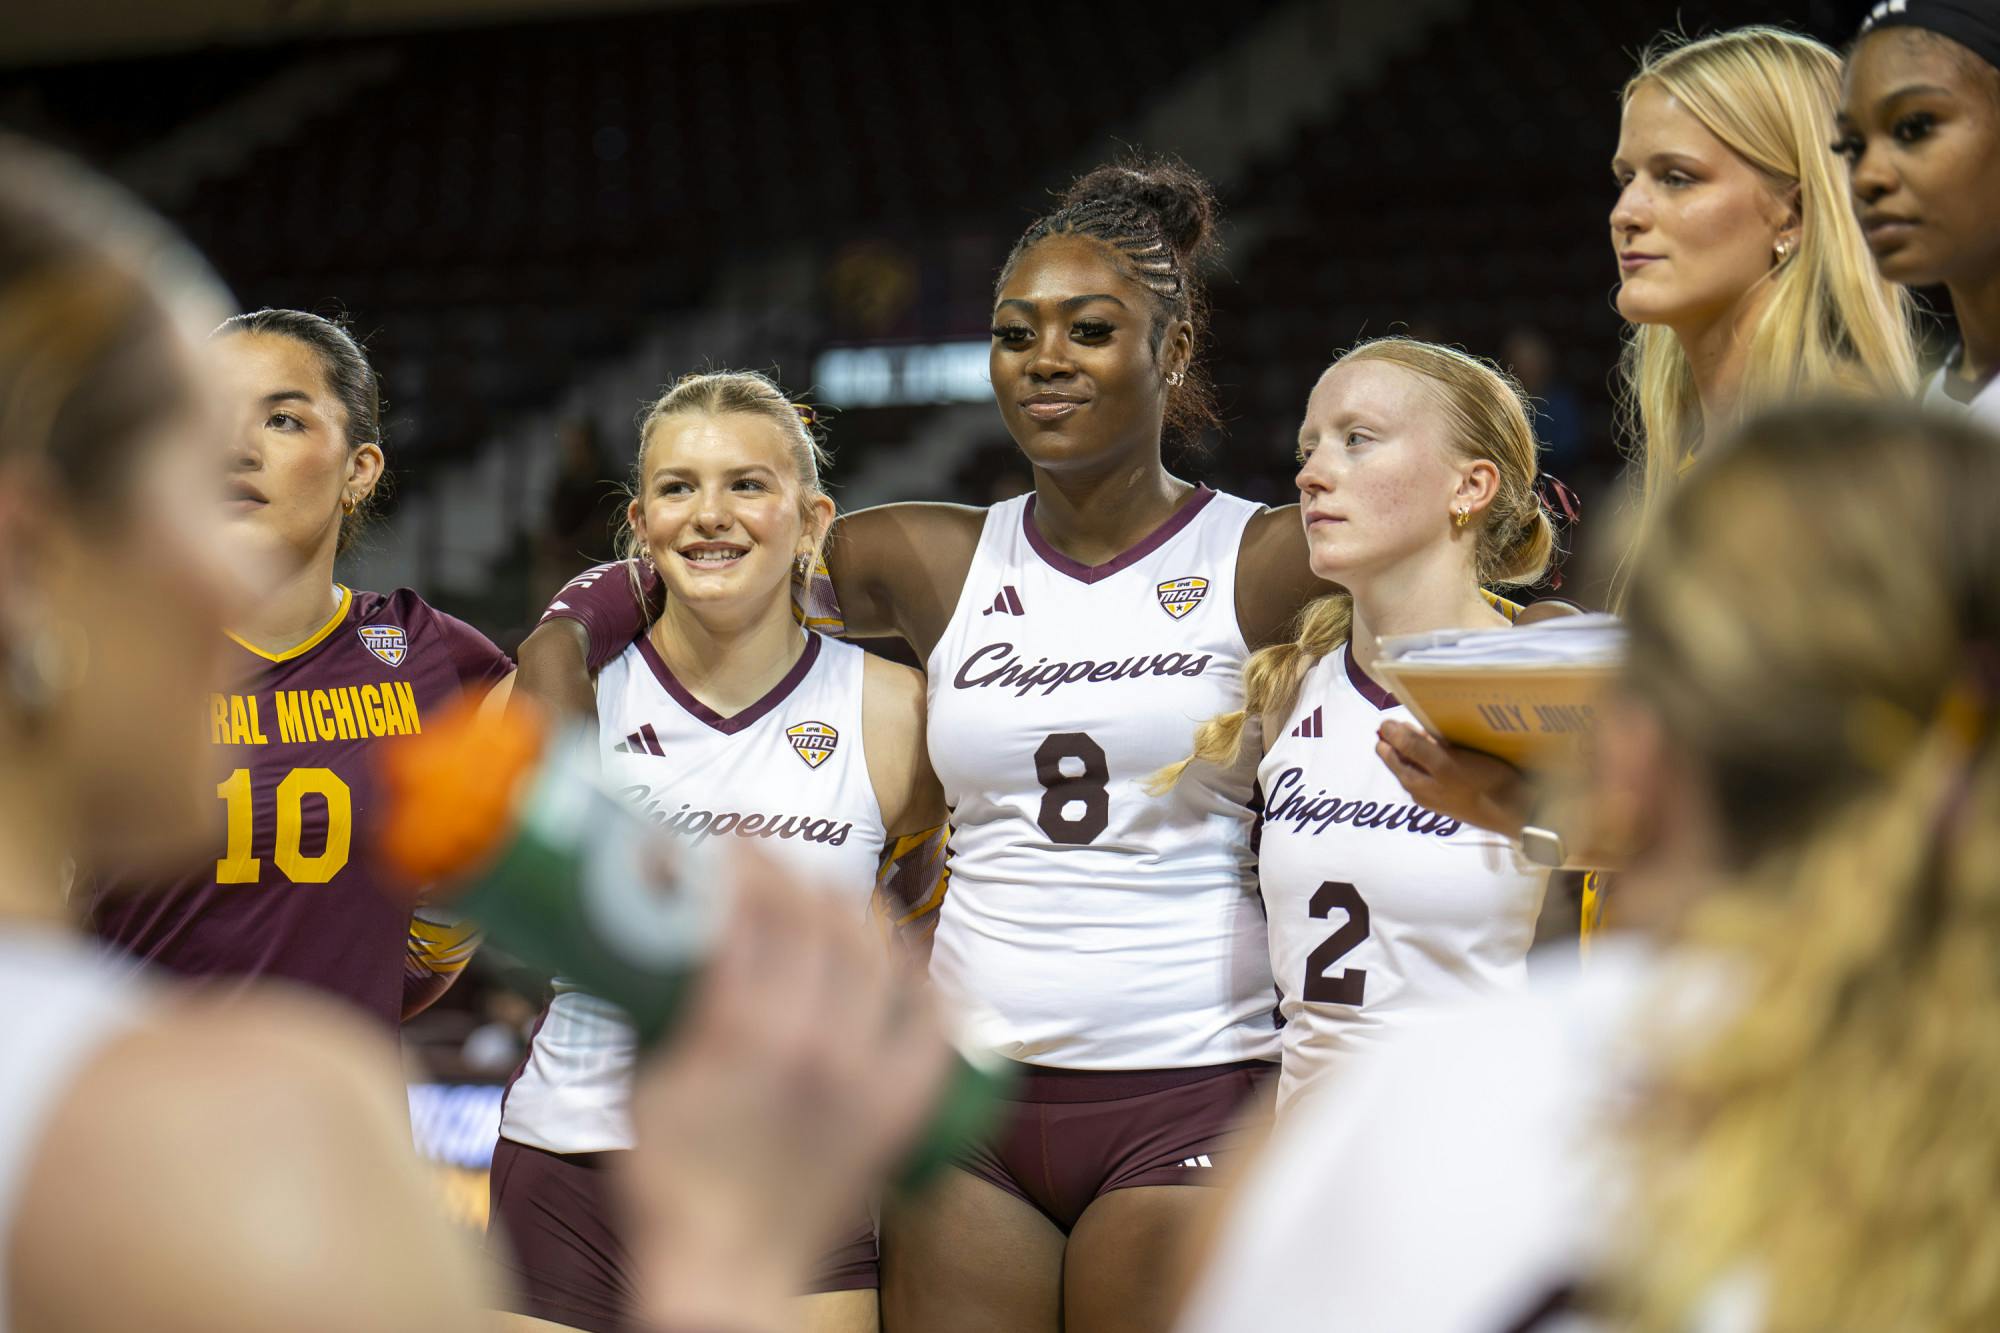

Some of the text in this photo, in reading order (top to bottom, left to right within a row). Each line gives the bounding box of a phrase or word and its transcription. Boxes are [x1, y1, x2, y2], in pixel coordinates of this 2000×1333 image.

[1159, 588, 1206, 602] MAC
[365, 637, 408, 649] MAC
[953, 642, 1213, 697] Chippewas
[210, 681, 421, 744] RAL MICHIGAN
[790, 735, 836, 750] MAC
[1034, 732, 1110, 845] 8
[1265, 767, 1464, 837] Chippewas
[216, 767, 351, 884] 10
[1303, 880, 1370, 1007] 2
